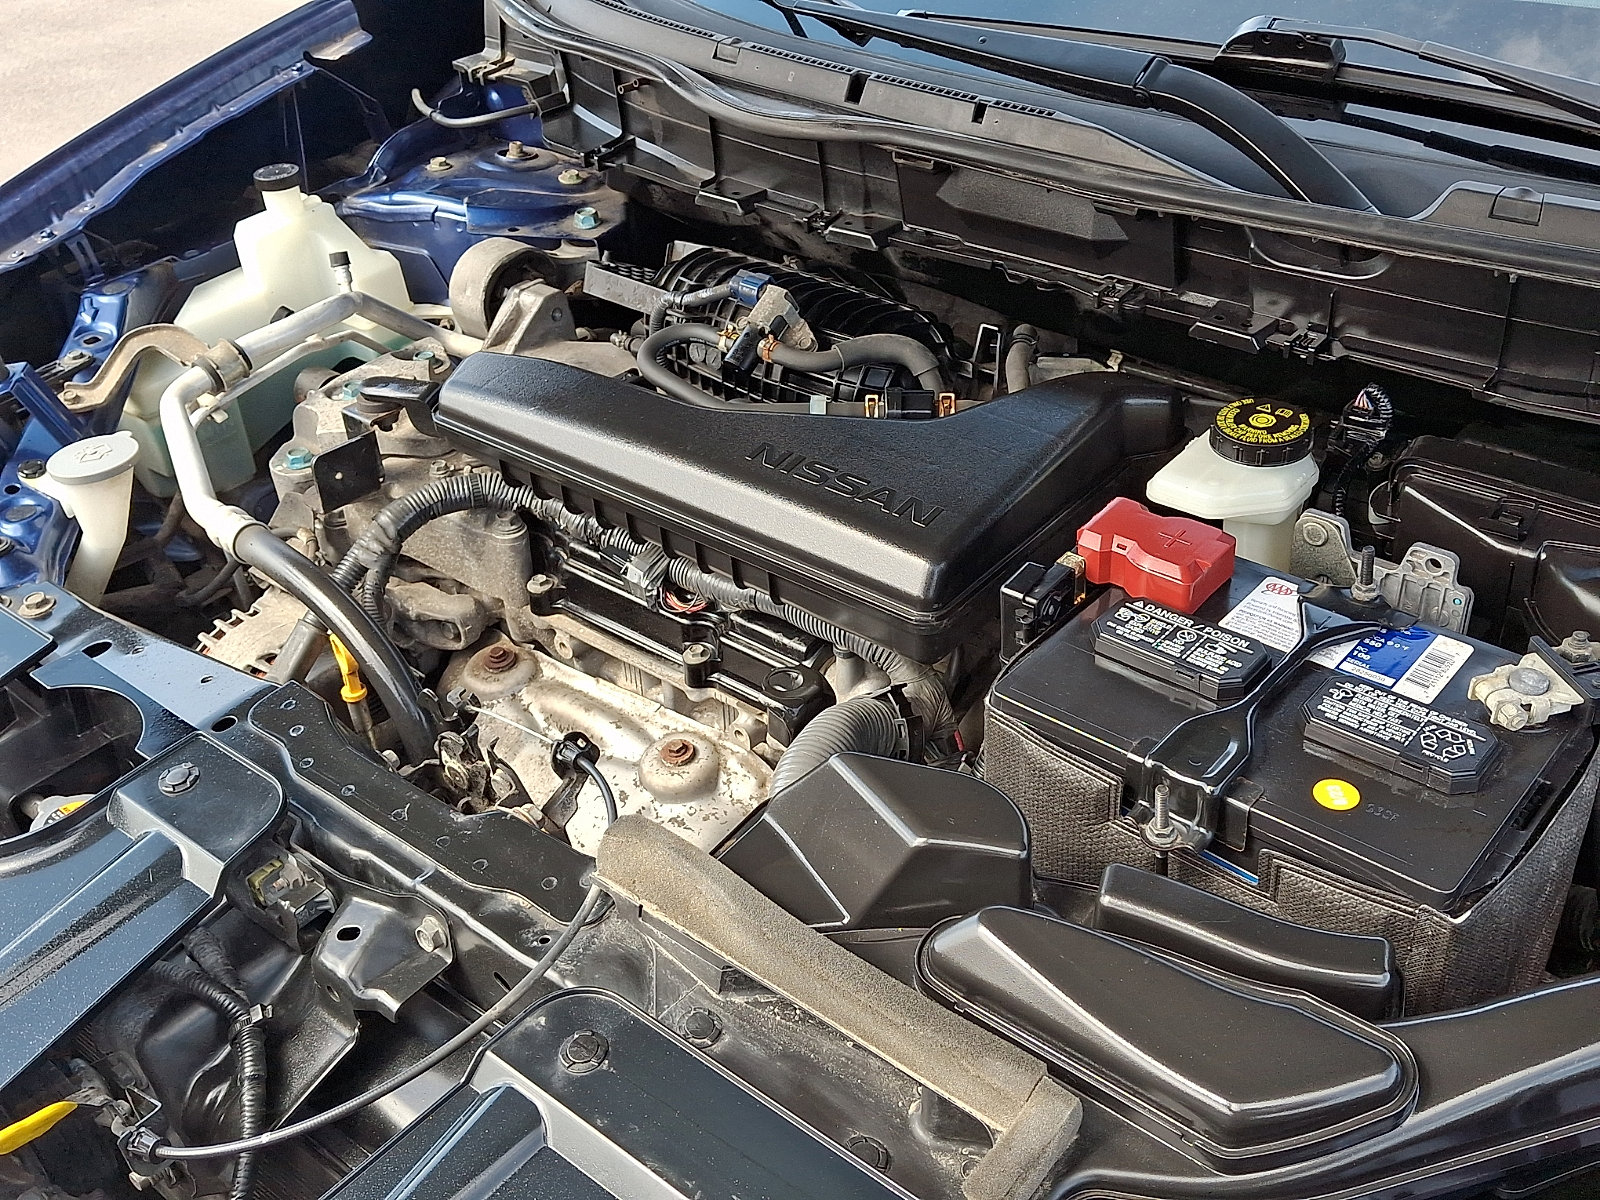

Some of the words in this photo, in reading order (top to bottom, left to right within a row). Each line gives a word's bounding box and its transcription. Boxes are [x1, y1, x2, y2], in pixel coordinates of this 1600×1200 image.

[744, 442, 945, 528] NISSAN
[1266, 582, 1293, 596] AAA
[1144, 603, 1194, 627] DANGER
[1203, 626, 1250, 648] POISON
[1352, 650, 1371, 660] 100
[1346, 657, 1371, 669] SERIAL
